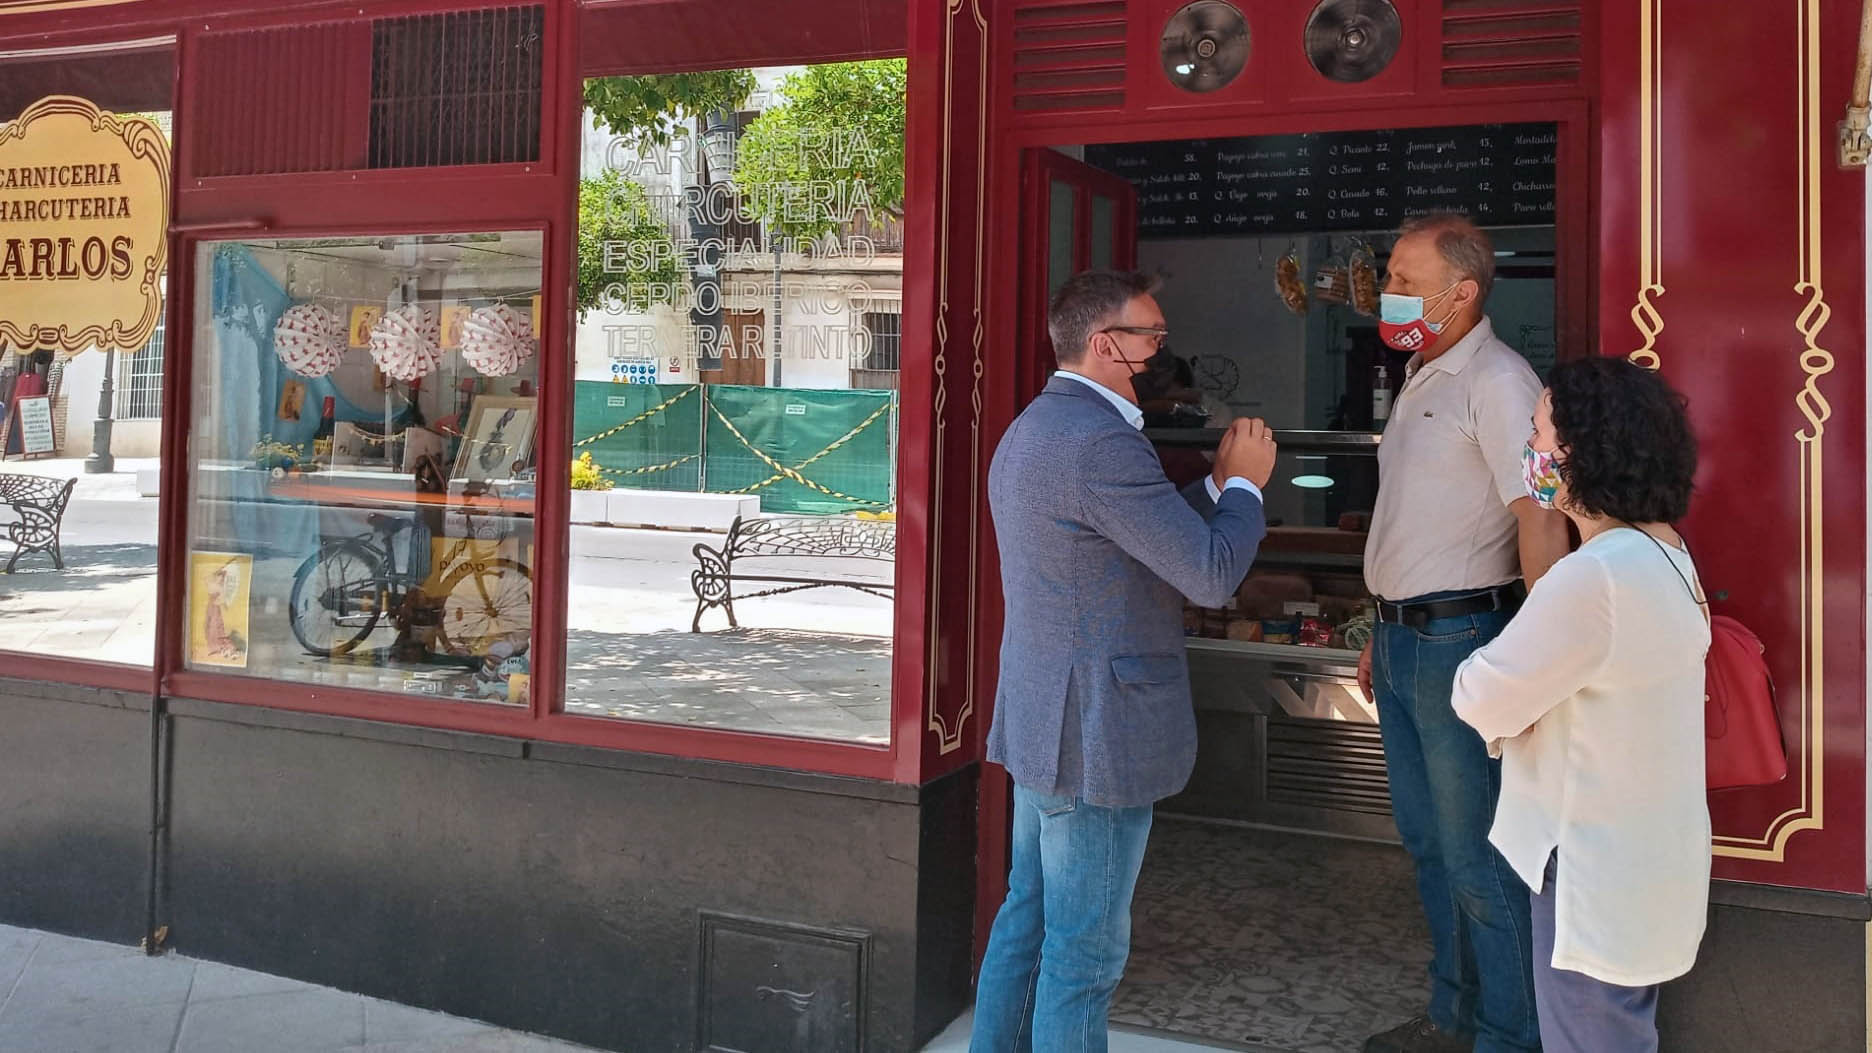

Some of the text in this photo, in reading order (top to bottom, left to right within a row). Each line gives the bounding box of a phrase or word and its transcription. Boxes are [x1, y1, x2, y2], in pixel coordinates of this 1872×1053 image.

[606, 126, 876, 177] CARNIERIA
[603, 281, 721, 316] CERDO
[602, 324, 737, 361] TERERA
